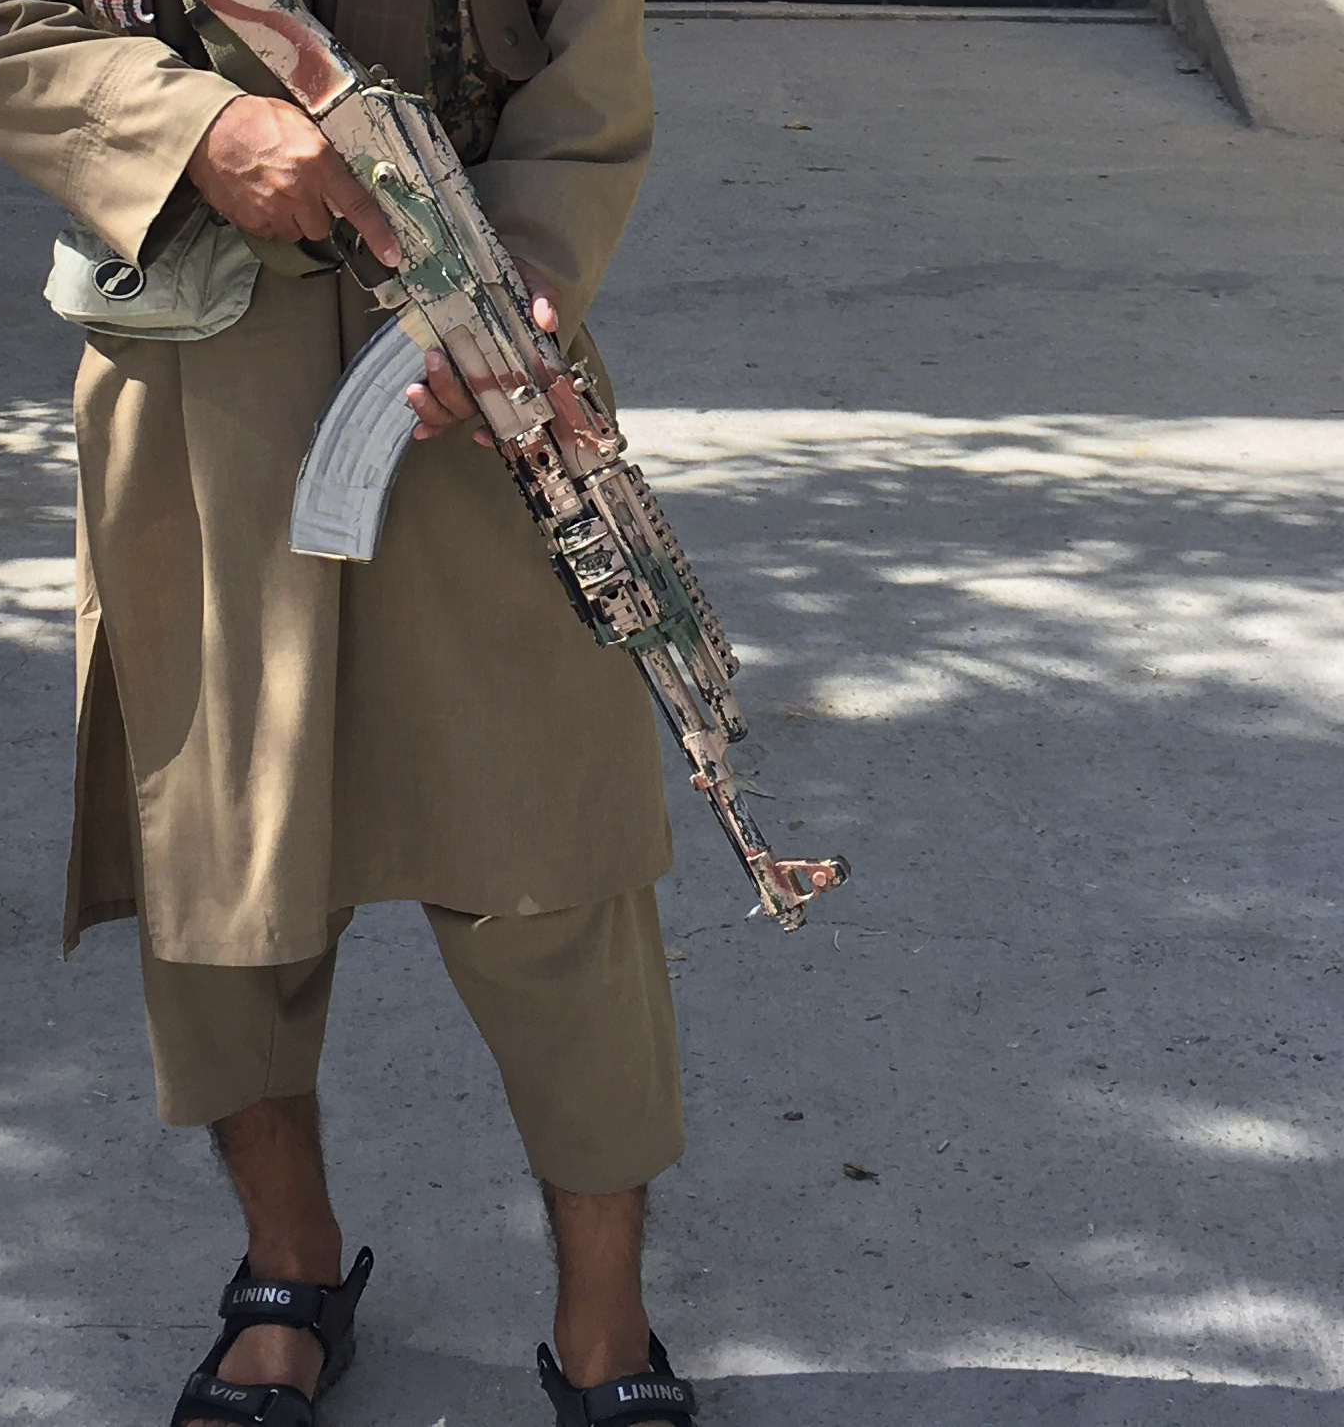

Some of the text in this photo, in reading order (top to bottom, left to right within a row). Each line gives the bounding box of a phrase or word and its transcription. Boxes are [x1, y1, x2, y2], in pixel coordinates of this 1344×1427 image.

[232, 1287, 291, 1305] LINING
[209, 1384, 248, 1402] VIP
[617, 1384, 684, 1402] LINING
